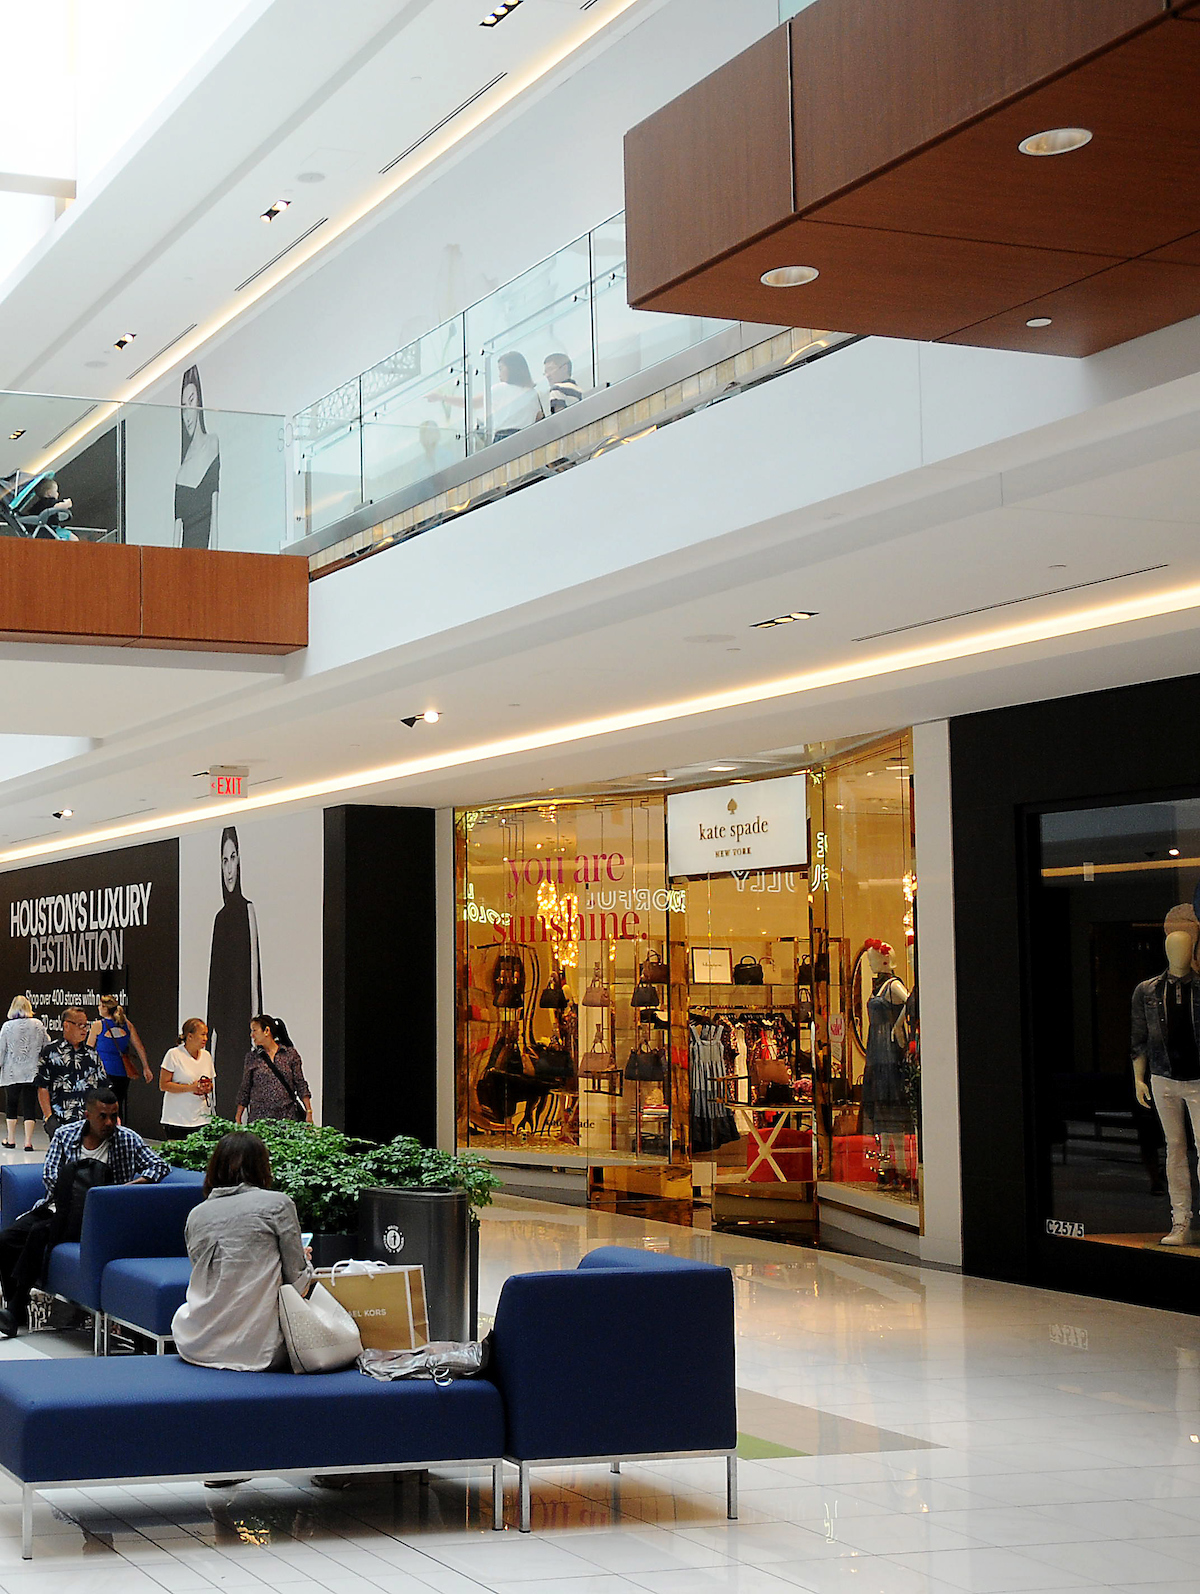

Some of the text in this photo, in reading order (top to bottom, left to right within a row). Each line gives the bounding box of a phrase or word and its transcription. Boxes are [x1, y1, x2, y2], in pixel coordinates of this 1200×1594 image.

[217, 776, 243, 795] EXIT
[698, 815, 769, 843] kate spade
[715, 846, 752, 858] NEW YORK
[507, 852, 626, 899] you are
[10, 881, 153, 938] HOUSTON'S LUXURY
[492, 898, 648, 944] sunshine.
[29, 929, 124, 974] DESTINATION
[52, 989, 65, 1006] 400
[65, 990, 82, 1006] stores
[82, 988, 96, 1006] with
[1047, 1220, 1084, 1237] C2575
[364, 1308, 387, 1317] KORS
